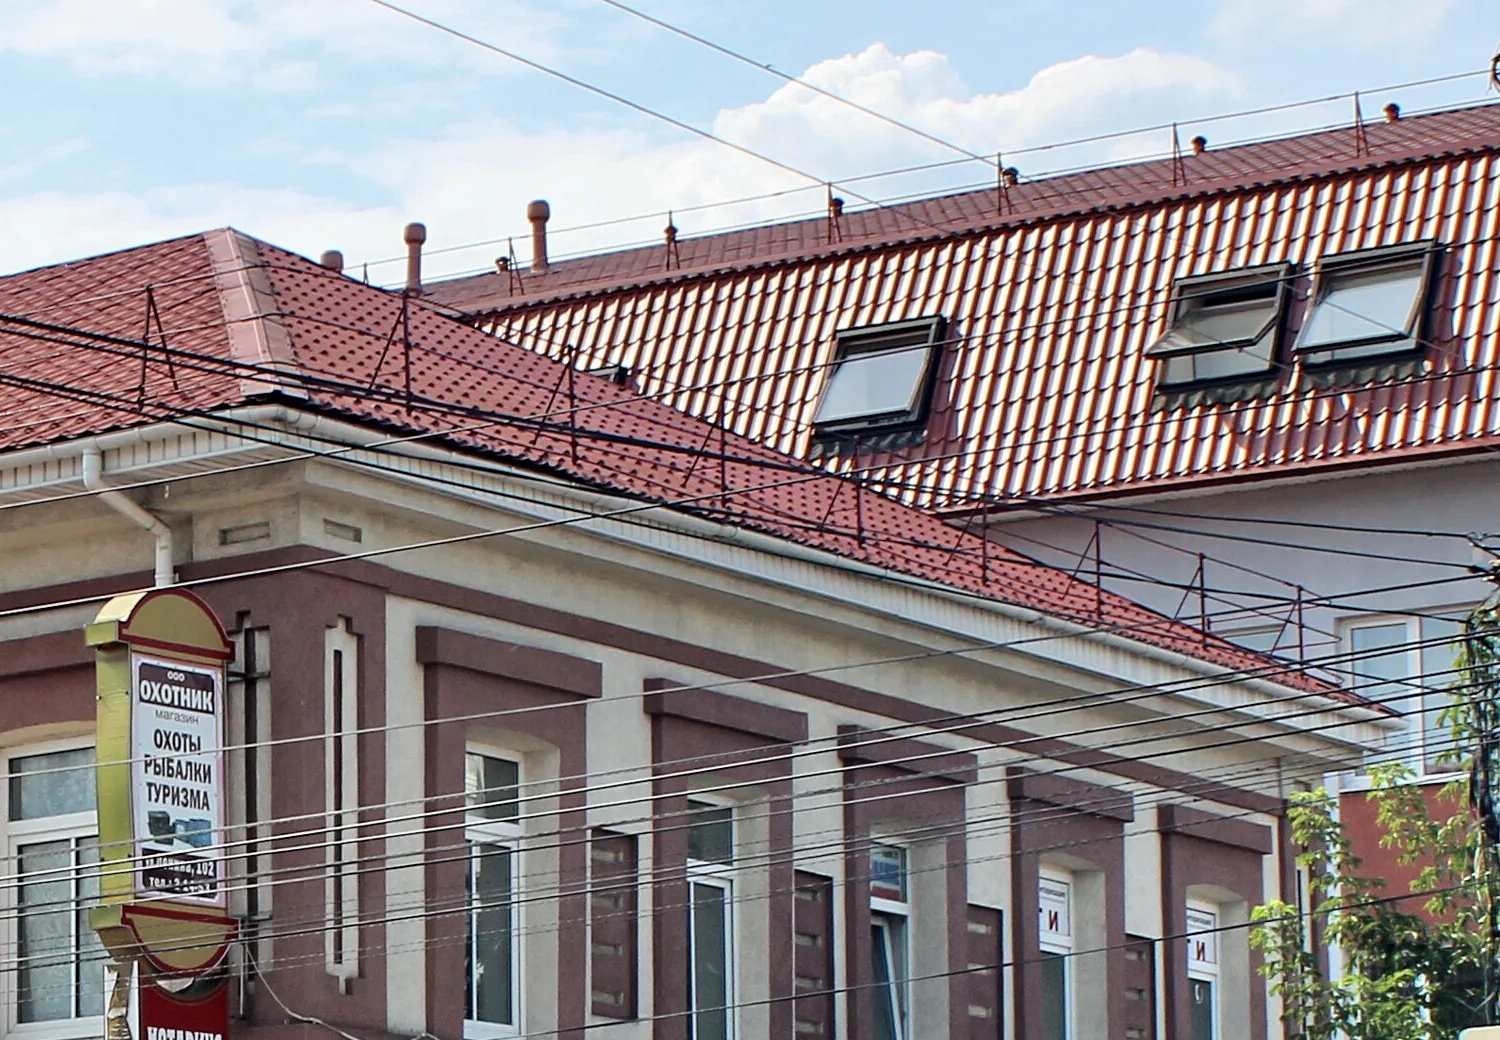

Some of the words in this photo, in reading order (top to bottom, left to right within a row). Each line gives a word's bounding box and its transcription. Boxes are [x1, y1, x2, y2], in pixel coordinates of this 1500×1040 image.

[140, 680, 213, 712] ОХОТНИК
[155, 709, 199, 724] магазин
[154, 729, 201, 755] ОХОТЫ
[144, 754, 211, 784] РЫБАЛКИ
[146, 782, 210, 811] ТУРИЗМА
